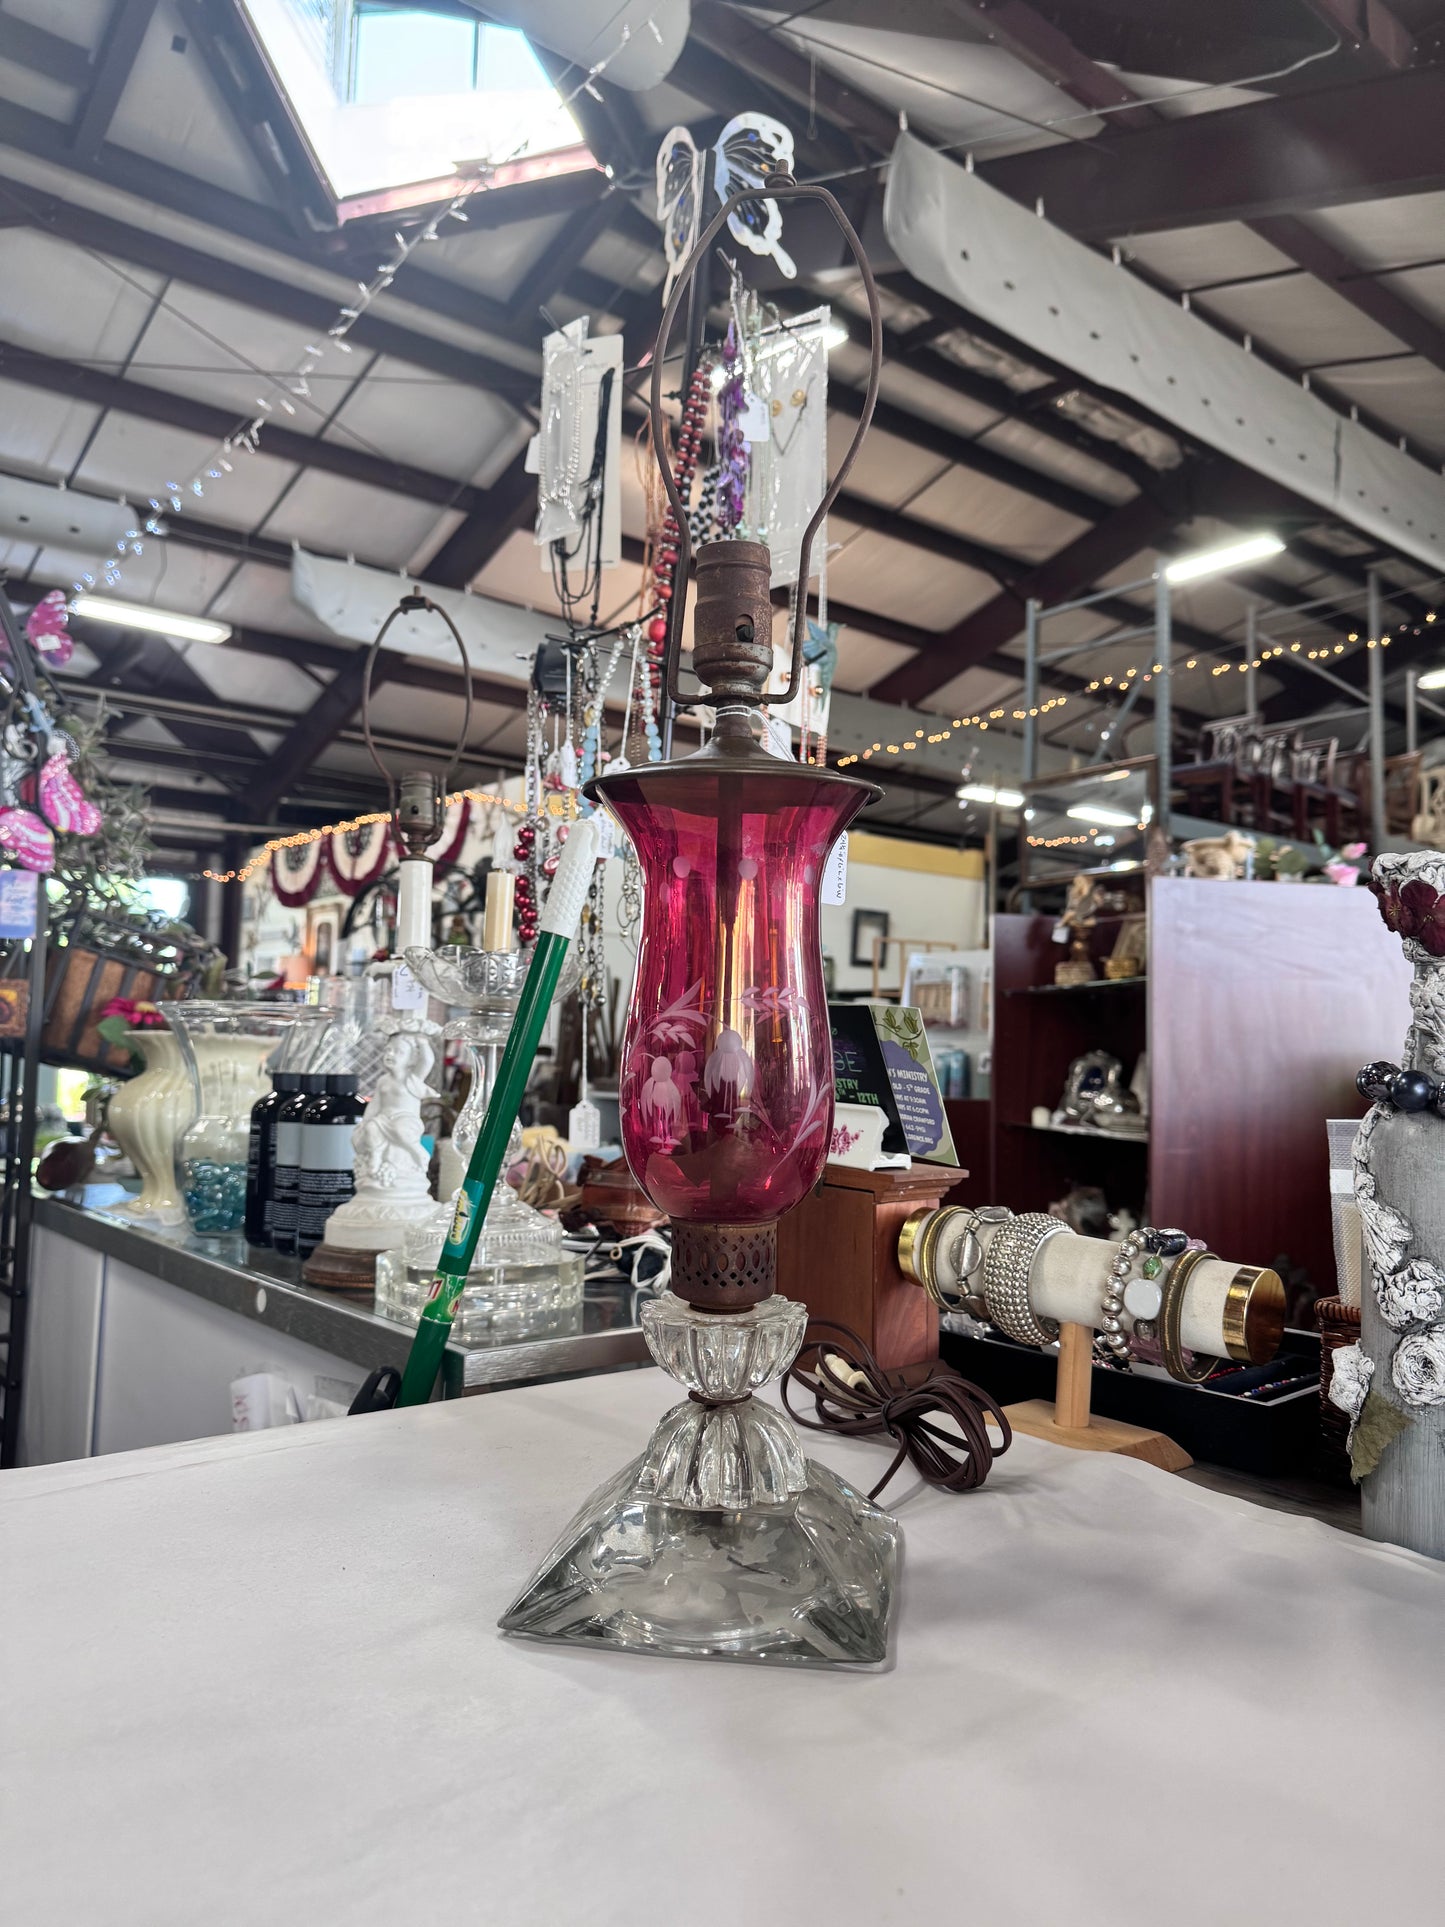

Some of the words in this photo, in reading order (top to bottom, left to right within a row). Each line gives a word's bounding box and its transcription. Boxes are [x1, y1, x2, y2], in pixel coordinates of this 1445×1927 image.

[897, 1069, 928, 1083] MINISTRY
[914, 1085, 931, 1095] GRADE
[857, 1092, 880, 1105] 12TH
[913, 1115, 936, 1126] CRAWFORD
